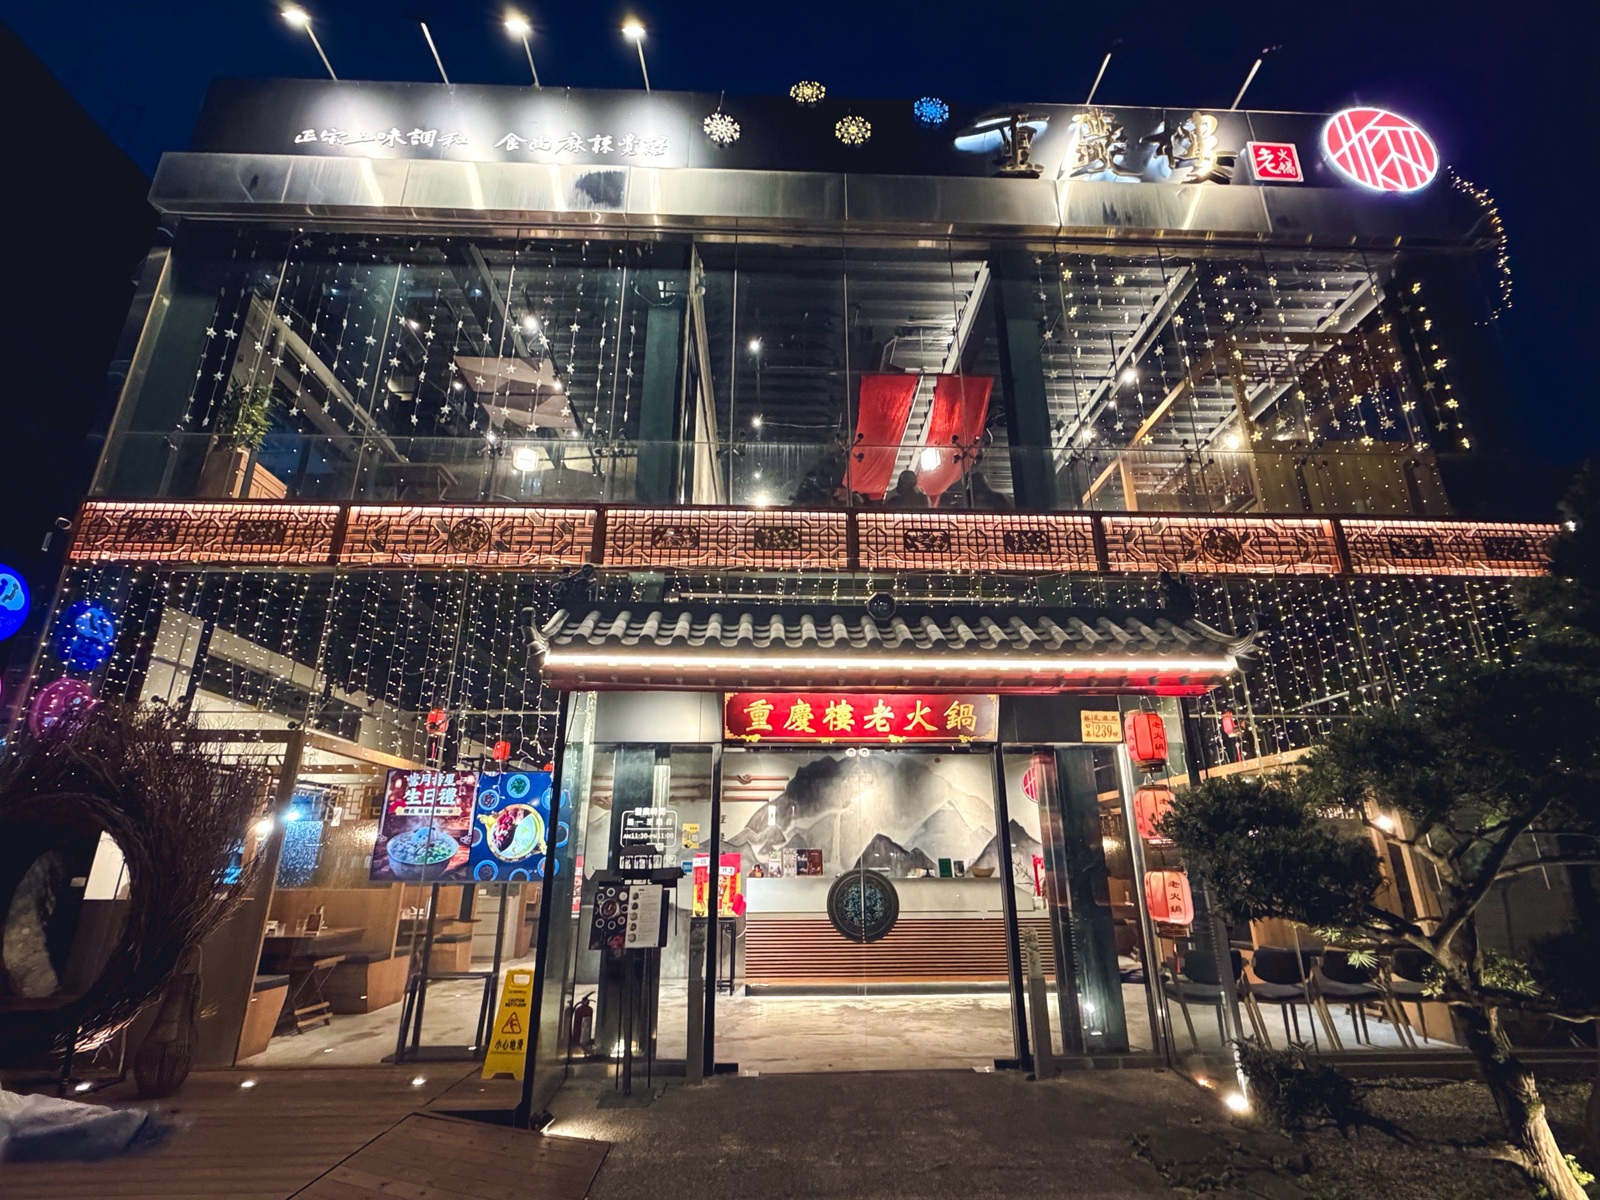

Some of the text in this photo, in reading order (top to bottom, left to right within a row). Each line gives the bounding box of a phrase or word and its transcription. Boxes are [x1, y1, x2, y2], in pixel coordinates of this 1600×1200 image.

[743, 698, 978, 734] 重慶樓老火鍋
[1151, 721, 1165, 750] 老火鍋
[403, 787, 457, 805] 生日禮
[1168, 880, 1183, 913] 老火鍋
[494, 1038, 524, 1051] 小心地滑
